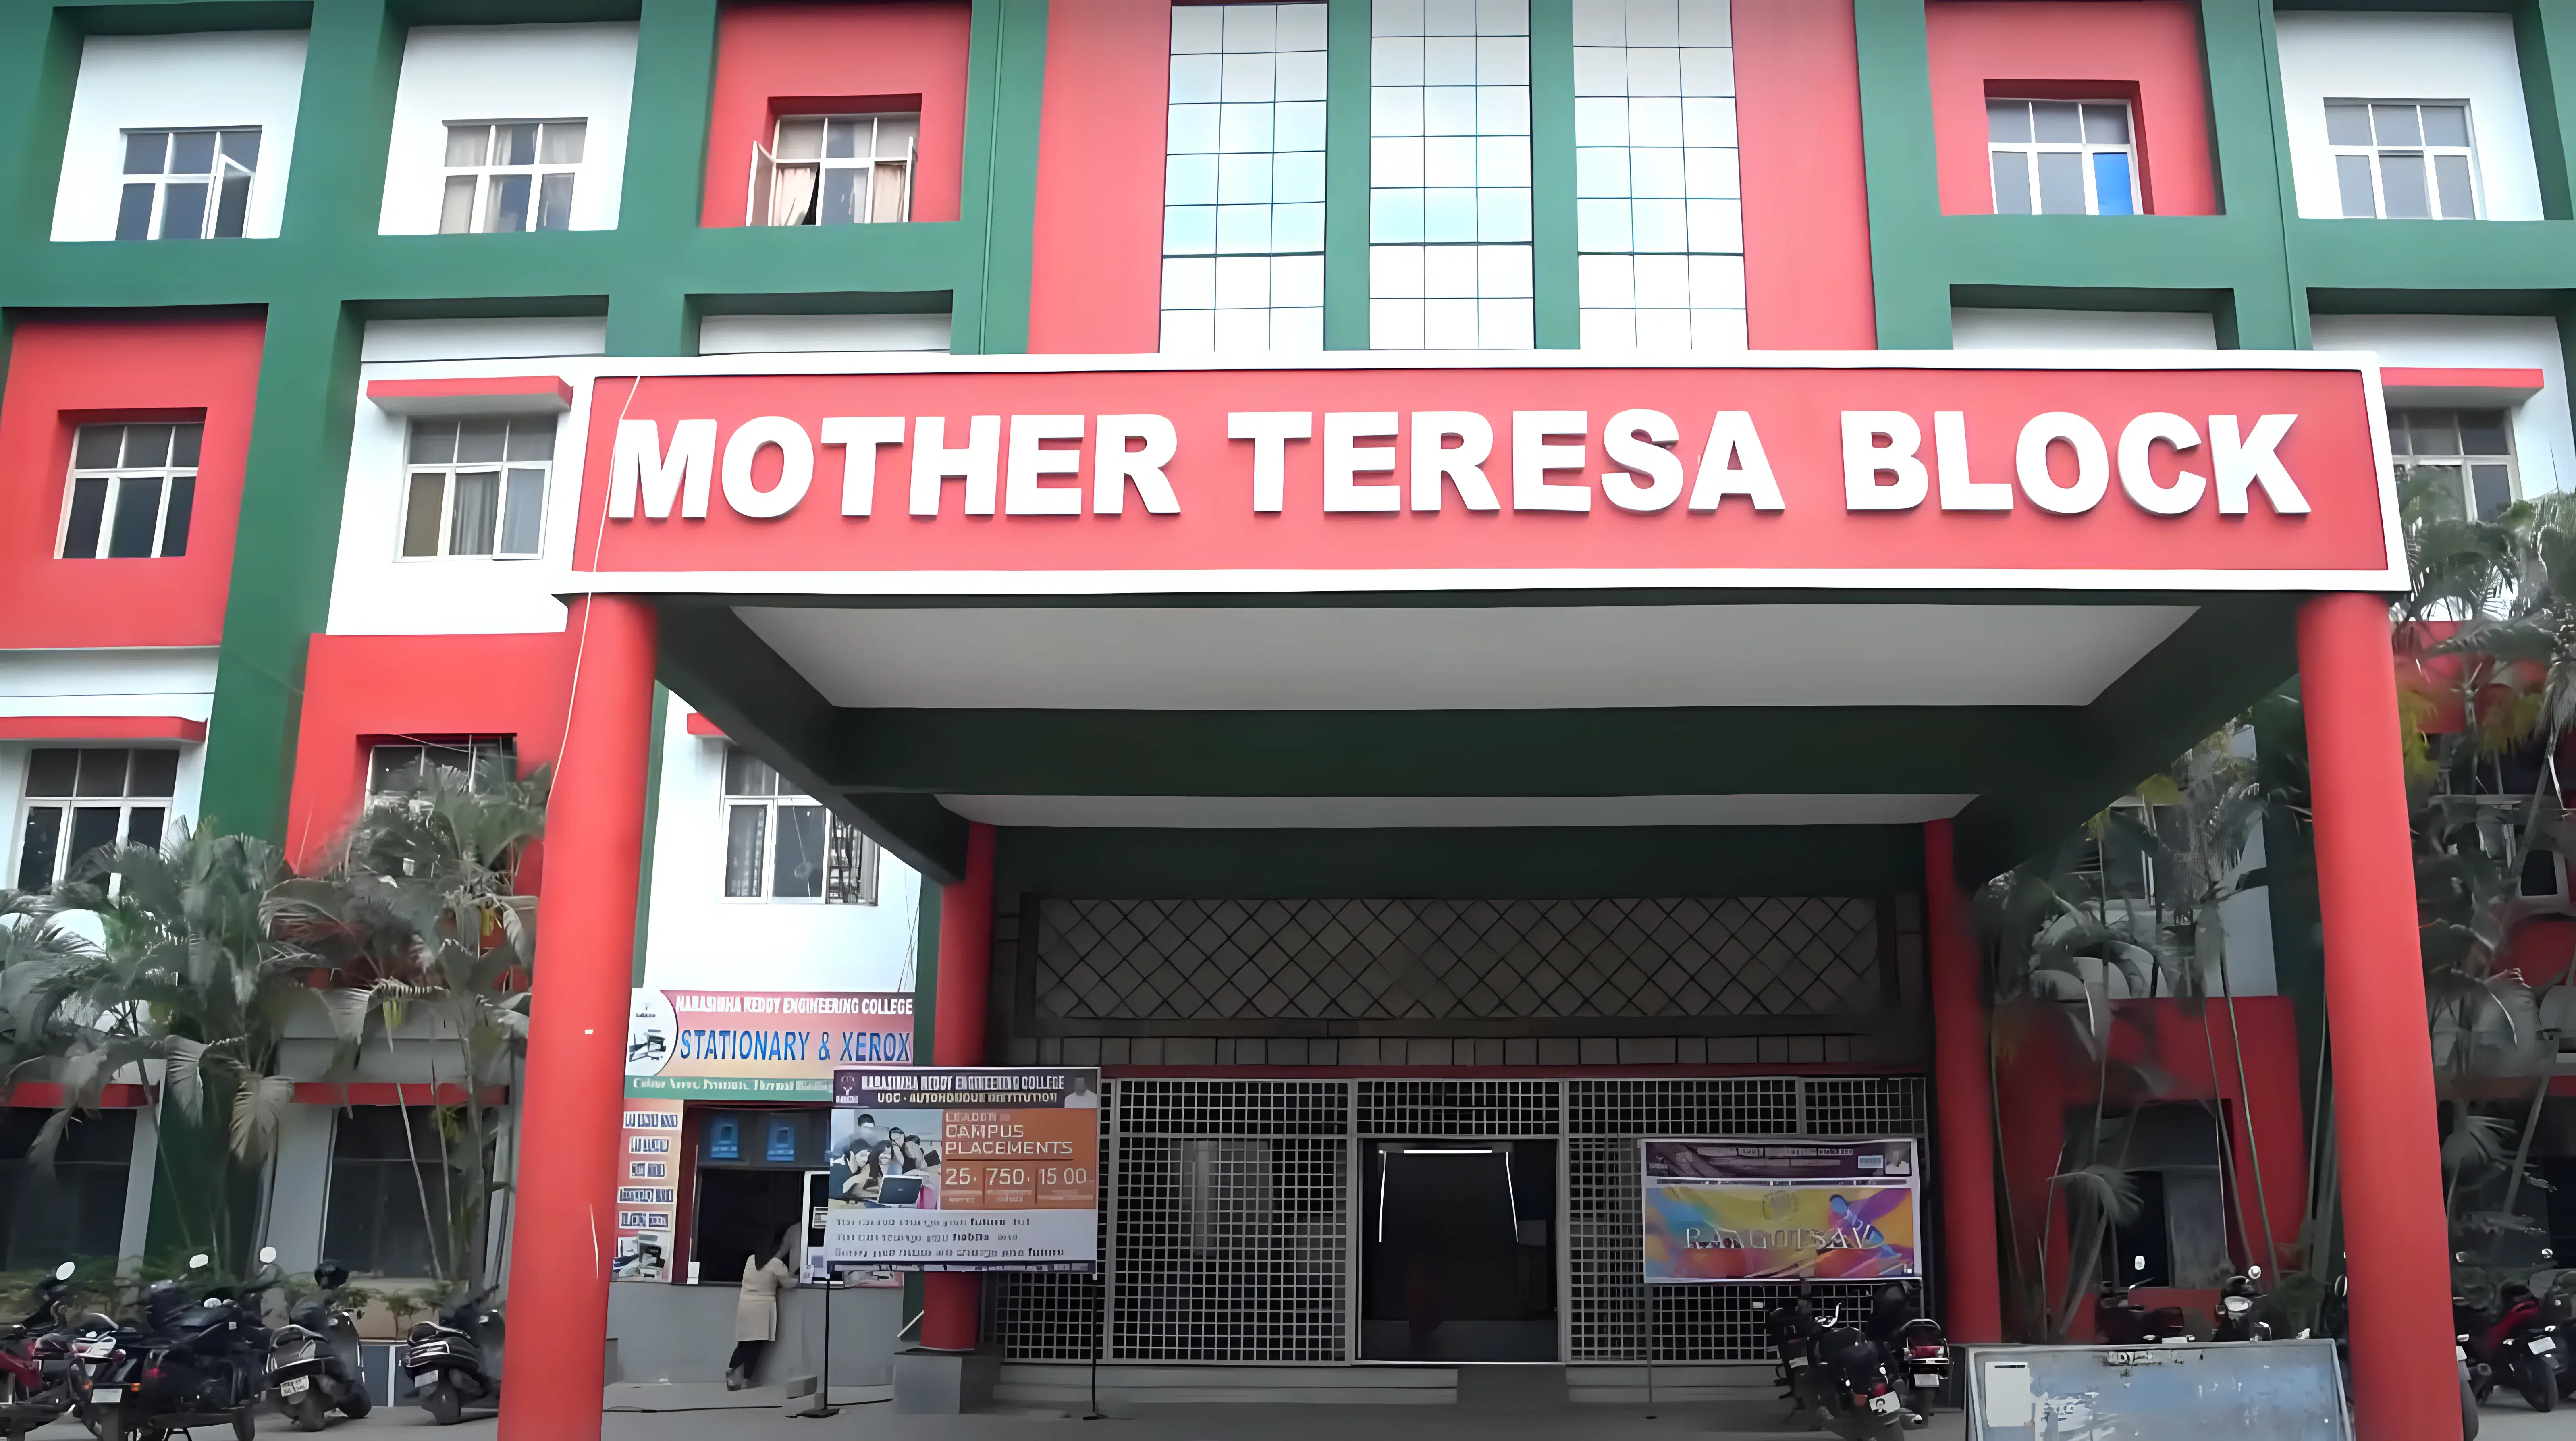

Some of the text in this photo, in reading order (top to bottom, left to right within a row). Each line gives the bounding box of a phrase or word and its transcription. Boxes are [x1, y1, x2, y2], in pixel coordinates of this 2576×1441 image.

[609, 408, 2312, 518] MOTHER TERESA BLOCK
[862, 998, 913, 1015] COLLEGE
[680, 1030, 912, 1061] STATIONARY & XEROX
[945, 1124, 1024, 1139] CAMPUS
[945, 1141, 1073, 1154] PLACEMENTS
